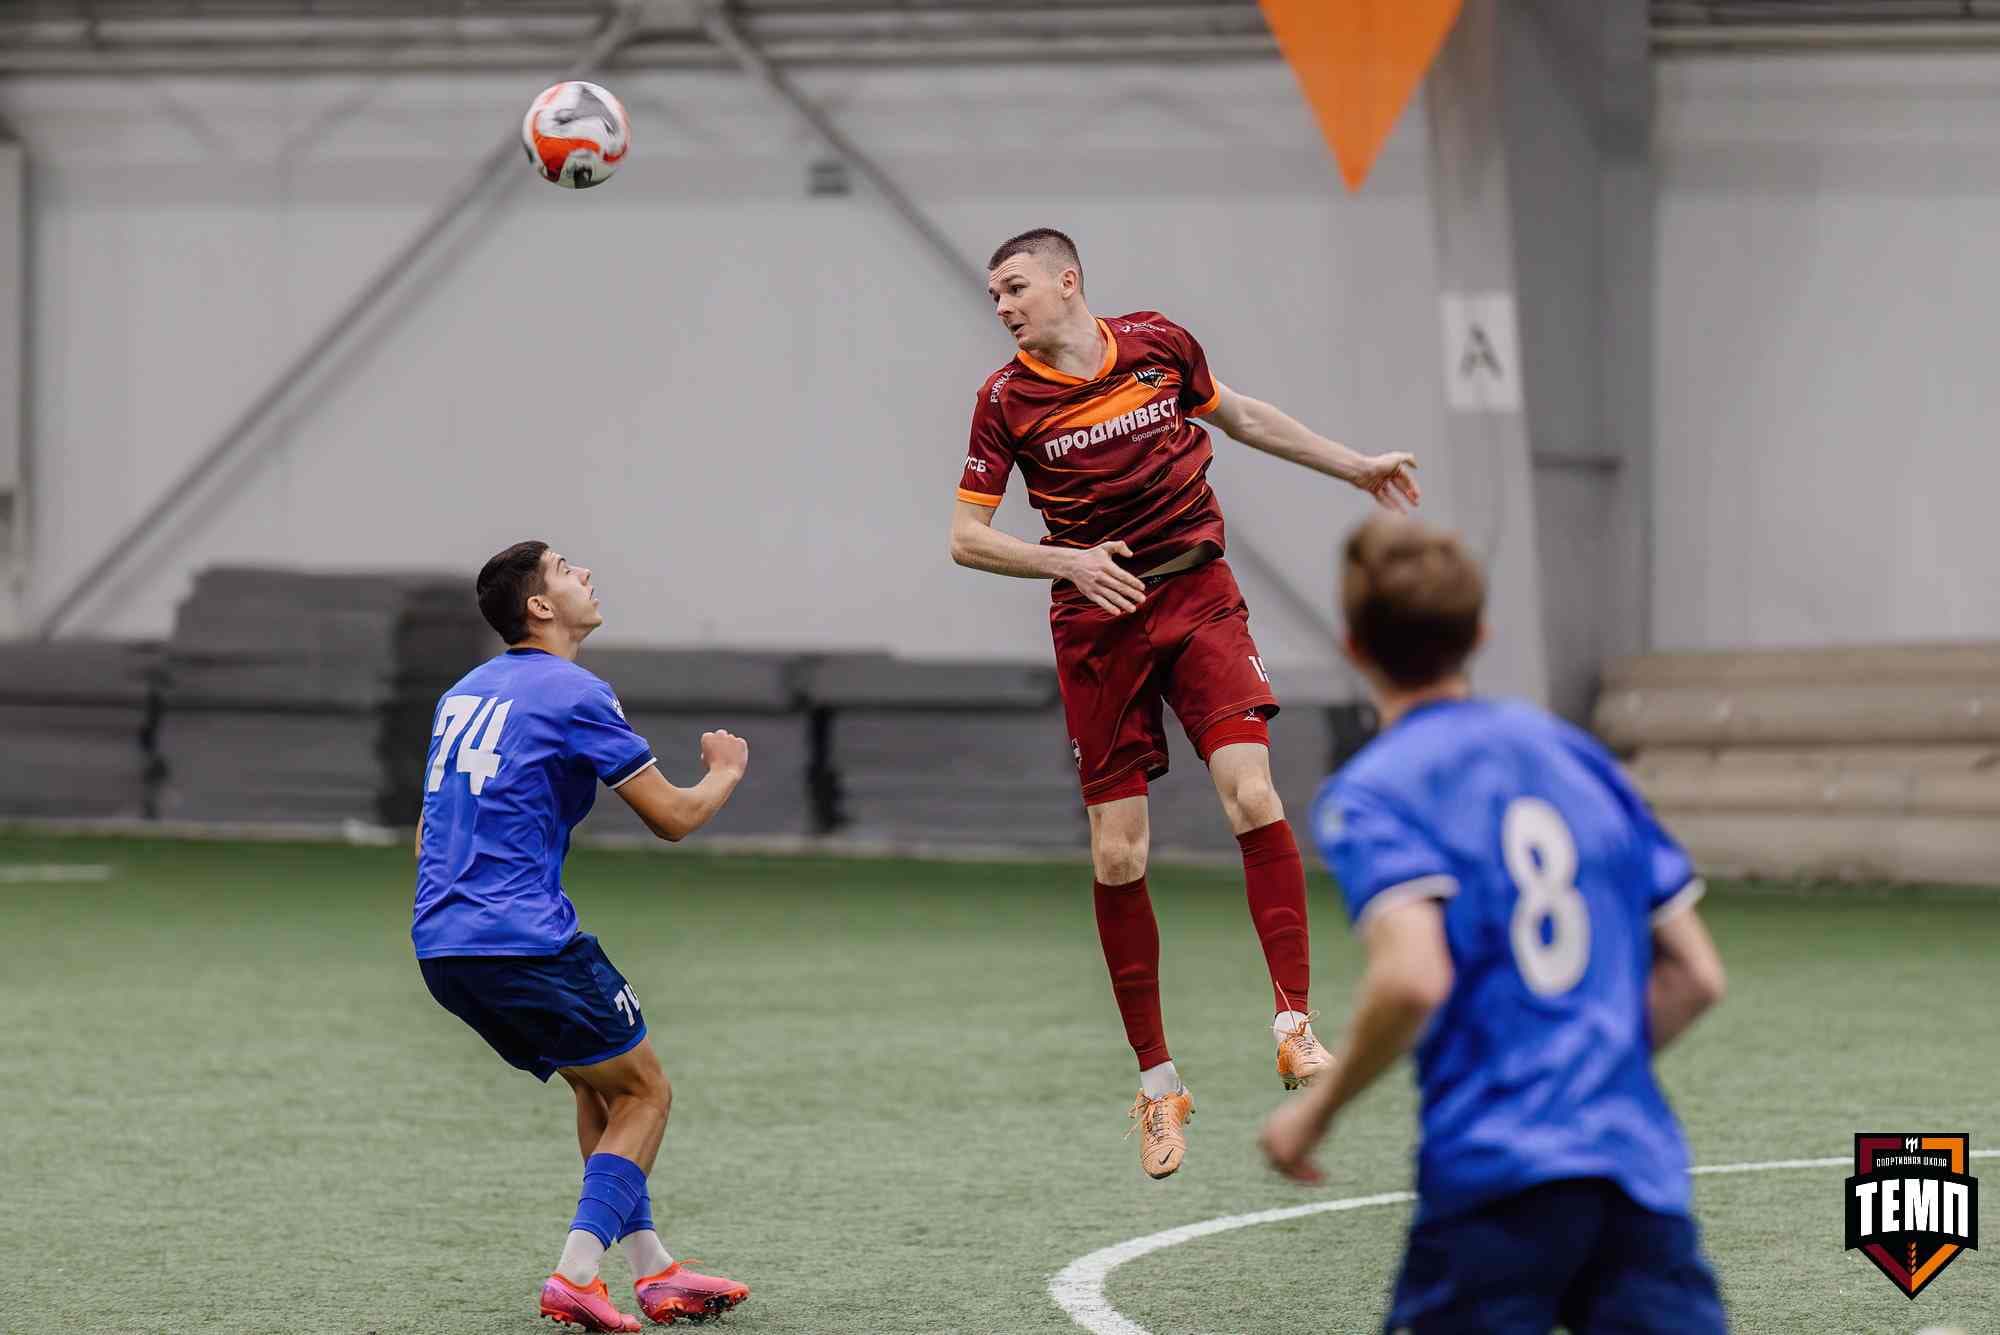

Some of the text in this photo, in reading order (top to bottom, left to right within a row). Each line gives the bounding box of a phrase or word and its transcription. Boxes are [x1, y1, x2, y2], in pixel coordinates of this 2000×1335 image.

[1044, 397, 1177, 462] ПРОДИНВЕСТ
[428, 695, 514, 796] 74
[1503, 797, 1592, 998] 8
